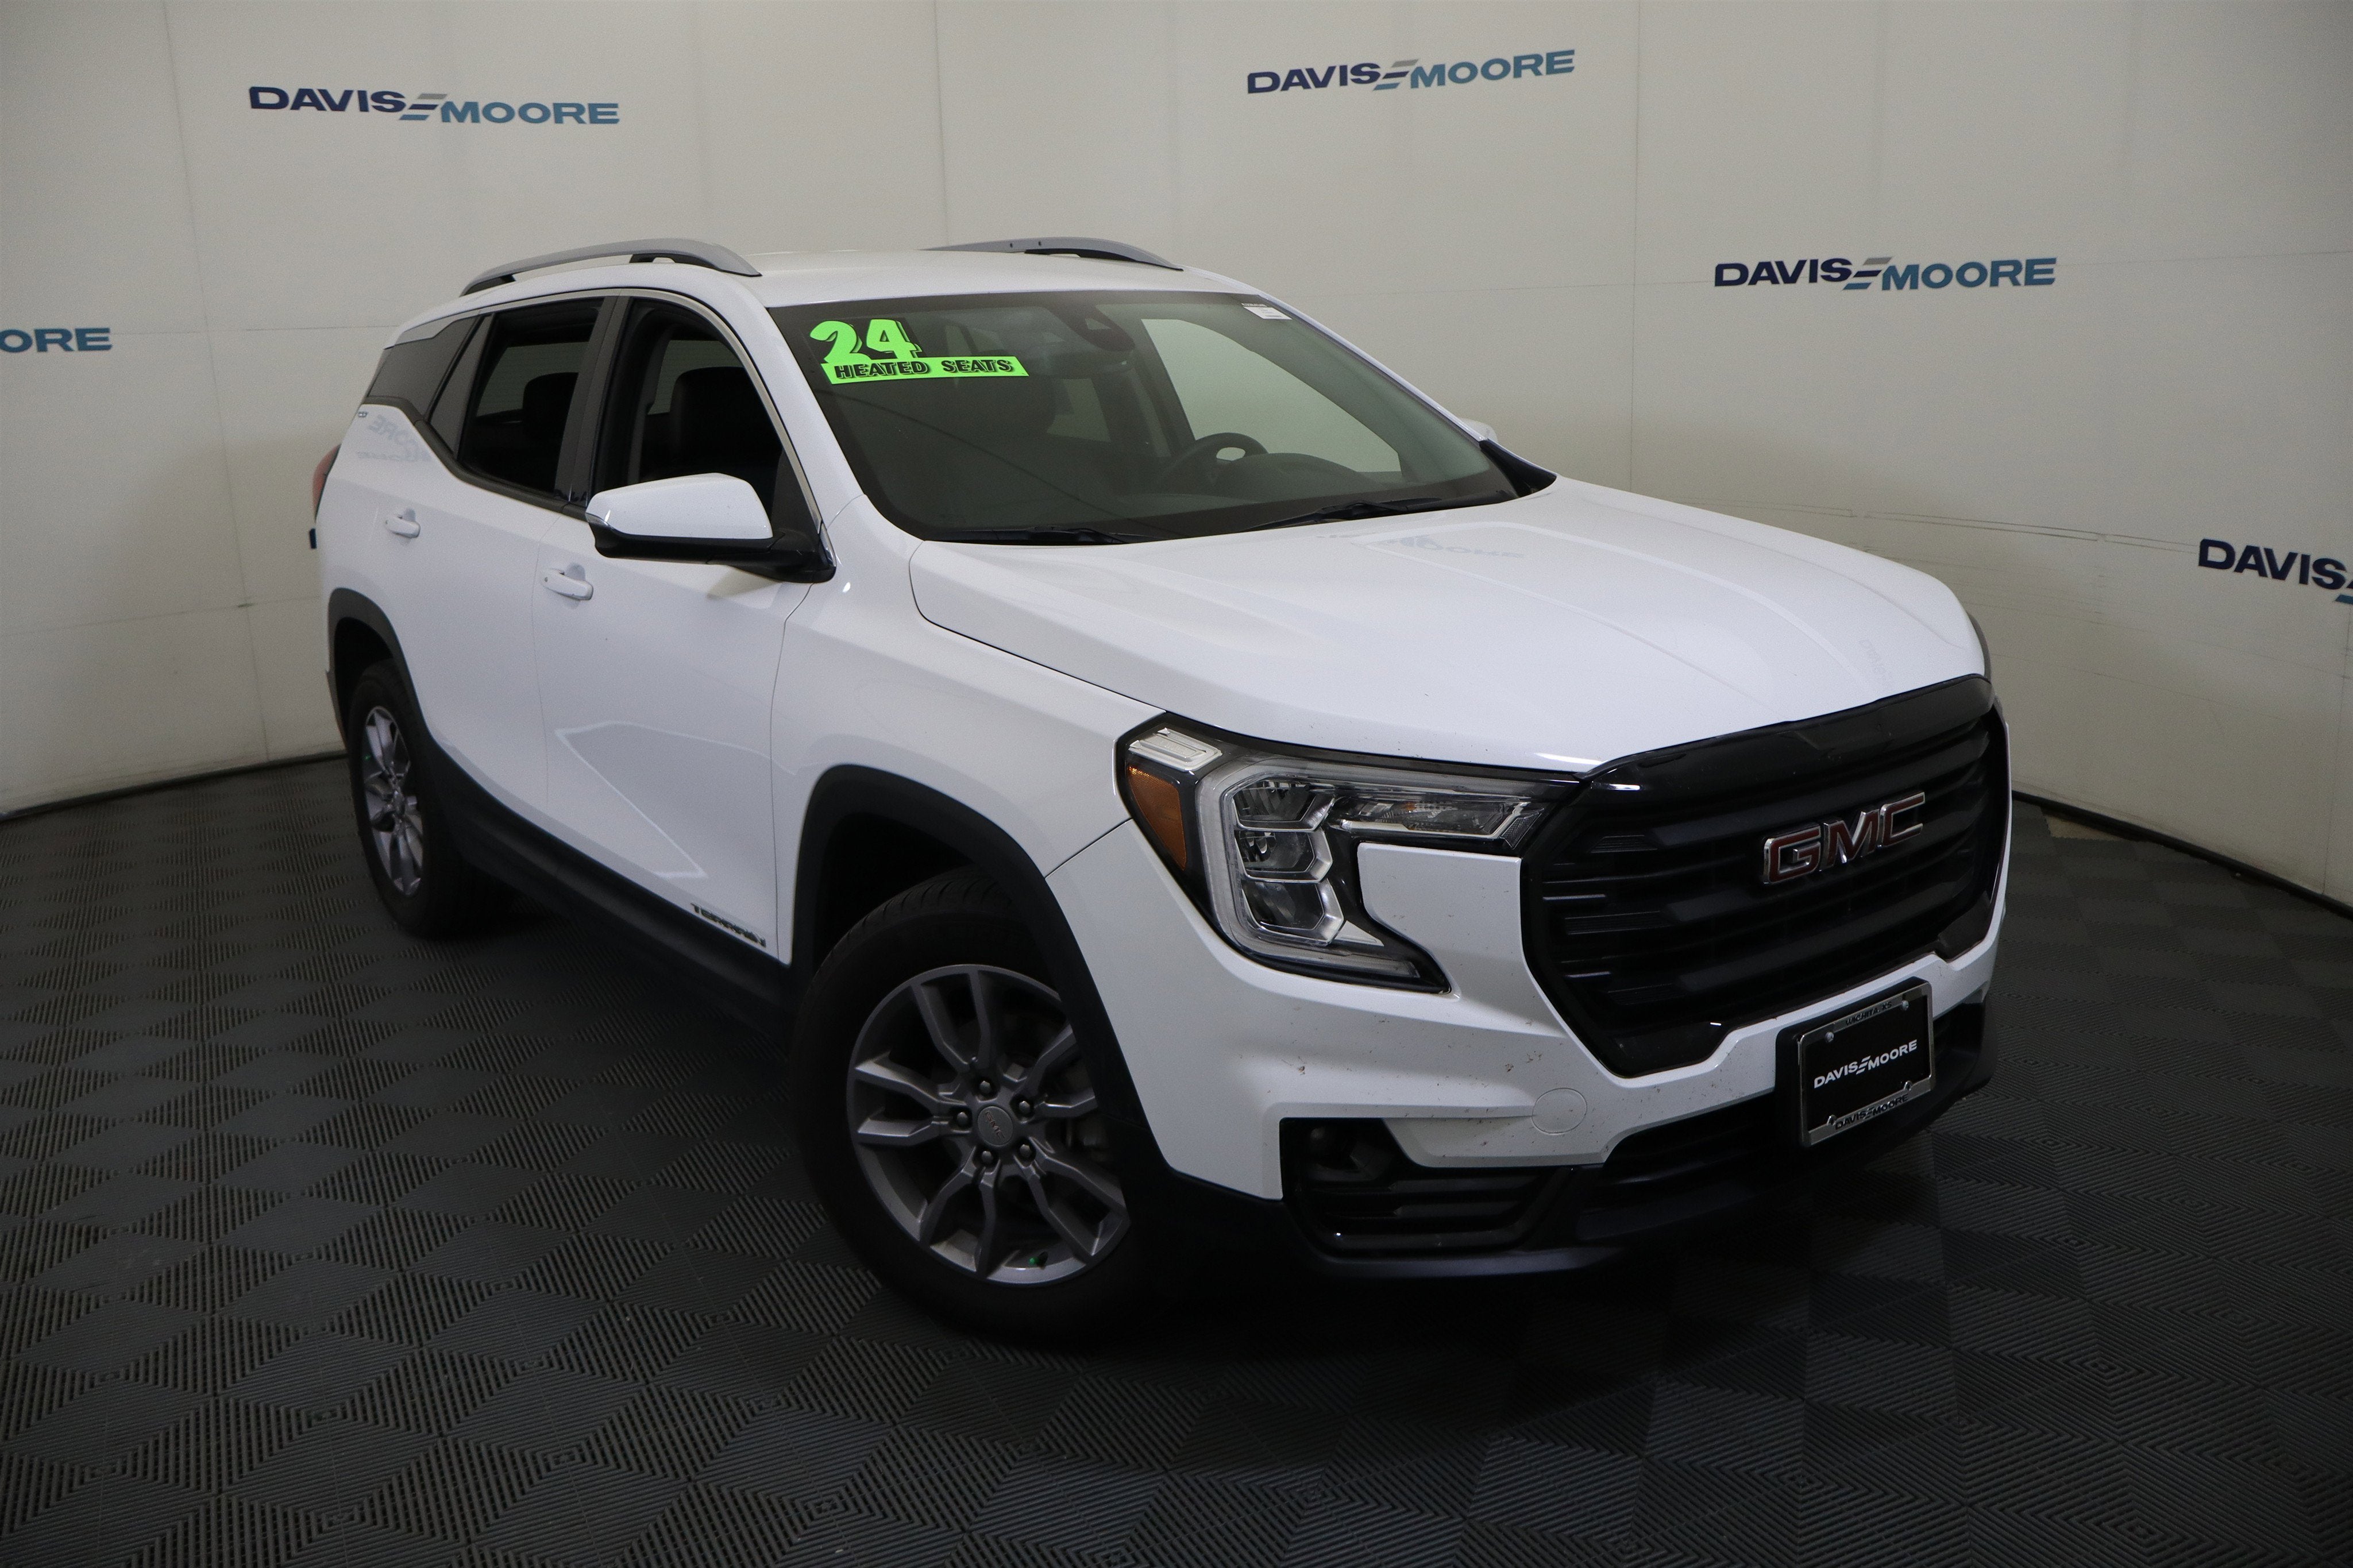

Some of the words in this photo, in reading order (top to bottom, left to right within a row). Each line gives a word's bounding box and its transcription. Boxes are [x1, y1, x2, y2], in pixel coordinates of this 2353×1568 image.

[1247, 62, 1382, 94] DAVIS
[1410, 49, 1575, 89] MOORE
[248, 86, 407, 113] DAVIS
[440, 101, 620, 124] MOORE
[1714, 257, 1853, 287] DAVIS
[1881, 257, 2057, 291] MOORE
[809, 318, 922, 364] 24
[834, 360, 931, 379] HEATED
[941, 358, 1015, 373] SEATS
[2198, 538, 2347, 590] DAVIS
[1762, 791, 1925, 885] GMC
[1814, 1061, 1858, 1089] DAVIS
[1868, 1039, 1918, 1071] MOORE
[1834, 1110, 1866, 1130] DAVIS
[1872, 1093, 1909, 1116] MOORE
